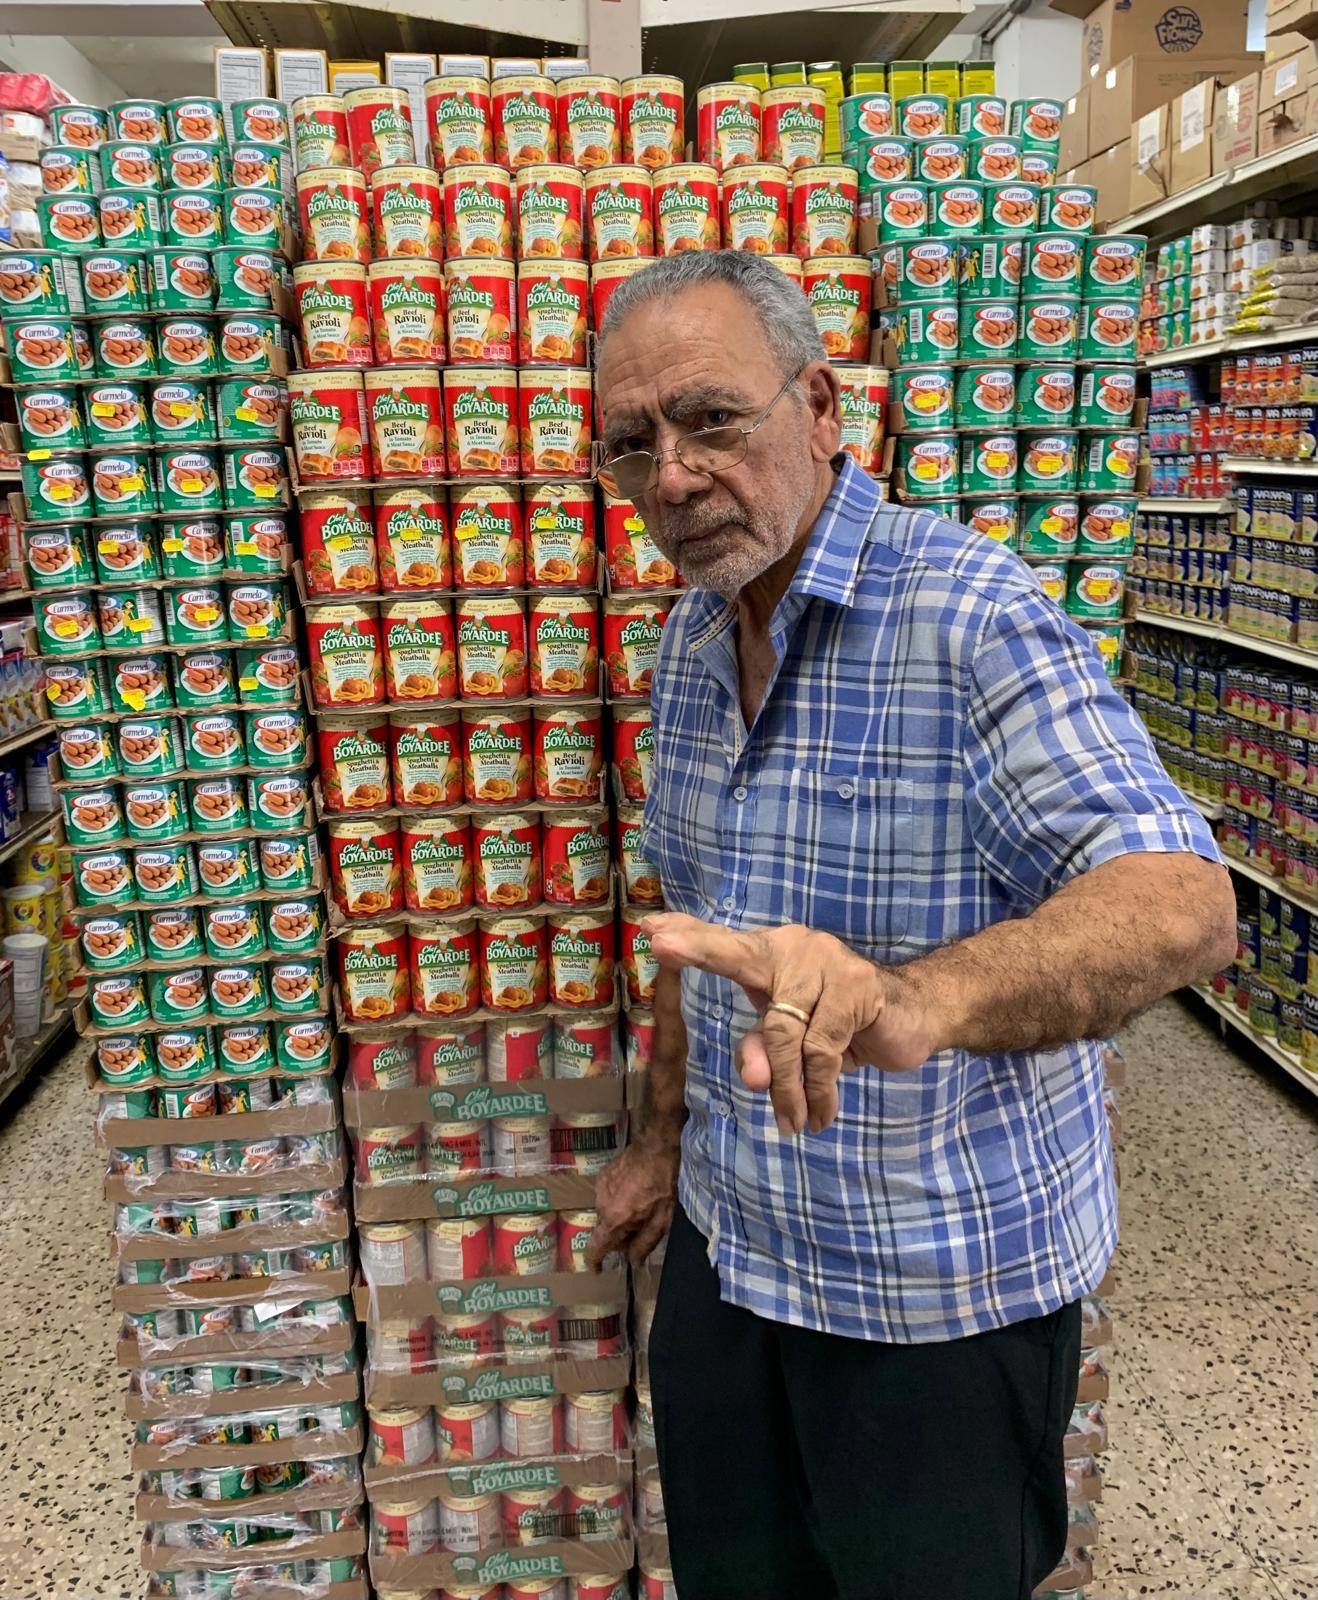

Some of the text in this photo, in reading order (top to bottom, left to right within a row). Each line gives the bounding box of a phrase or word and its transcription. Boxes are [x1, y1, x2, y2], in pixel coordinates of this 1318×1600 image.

[441, 97, 456, 110] Chef
[507, 97, 521, 109] Chef
[572, 97, 586, 109] Chef
[436, 104, 485, 121] BOYARDEE
[502, 104, 550, 121] BOYARDEE
[567, 105, 616, 121] BOYARDEE
[629, 105, 677, 122] BOYARDEE
[311, 188, 327, 202] Chef
[595, 188, 610, 201] Chef
[810, 188, 826, 201] Chef
[308, 195, 359, 214] BOYARDEE
[380, 195, 431, 214] BOYARDEE
[454, 195, 505, 214] BOYARDEE
[519, 195, 568, 214] BOYARDEE
[591, 195, 642, 214] BOYARDEE
[659, 195, 709, 214] BOYARDEE
[729, 195, 778, 214] BOYARDEE
[806, 196, 854, 215] BOYARDEE
[0, 261, 27, 271] Carmela
[90, 258, 116, 269] Carmela
[183, 257, 208, 267] Carmela
[386, 283, 403, 296] Chef
[531, 283, 548, 296] Chef
[382, 292, 436, 308] BOYARDEE
[527, 292, 580, 308] BOYARDEE
[310, 316, 341, 328] Ravioli
[317, 312, 331, 320] Beef
[394, 314, 426, 325] Ravioli
[25, 327, 56, 338] Carmela
[167, 326, 194, 336] Carmela
[226, 325, 253, 334] Carmela
[30, 396, 58, 406] Carmela
[99, 391, 127, 401] Carmela
[157, 390, 184, 400] Carmela
[376, 393, 394, 406] Chef
[458, 392, 474, 402] Chef
[533, 393, 550, 403] Chef
[372, 402, 428, 420] BOYARDEE
[453, 401, 509, 418] BOYARDEE
[528, 401, 584, 419] BOYARDEE
[384, 426, 416, 437] Ravioli
[464, 426, 497, 435] Ravioli
[540, 426, 572, 436] Ravioli
[178, 457, 206, 467] Carmela
[251, 455, 279, 465] Carmela
[98, 462, 125, 472] Carmela
[327, 514, 345, 524] Chef
[392, 511, 408, 520] Chef
[461, 510, 478, 522] Chef
[468, 540, 499, 548] Meatballs
[541, 538, 571, 547] Meatballs
[236, 590, 263, 600] Carmela
[391, 621, 408, 635] Chef
[461, 620, 476, 633] Chef
[541, 619, 558, 631] Chef
[325, 625, 342, 640] Chef
[458, 629, 509, 646] BOYARDEE
[536, 627, 590, 642] BOYARDEE
[320, 634, 375, 651] BOYARDEE
[388, 631, 442, 648] BOYARDEE
[549, 648, 578, 657] Meatballs
[191, 658, 218, 668] Carmela
[335, 657, 366, 667] Meatballs
[201, 720, 229, 731] Carmela
[64, 732, 90, 741] Carmela
[122, 728, 147, 737] Carmela
[401, 732, 419, 745] Chef
[473, 729, 490, 741] Chef
[548, 726, 565, 739] Chef
[338, 735, 356, 749] Chef
[397, 740, 450, 756] BOYARDEE
[469, 737, 522, 750] BOYARDEE
[543, 735, 595, 749] BOYARDEE
[554, 756, 585, 767] Ravioli
[131, 791, 158, 801] Carmela
[415, 838, 432, 851] Chef
[485, 835, 502, 848] Chef
[343, 844, 359, 854] Chef
[411, 845, 464, 862] BOYARDEE
[480, 843, 532, 858] BOYARDEE
[139, 856, 165, 866] Carmela
[340, 848, 394, 866] BOYARDEE
[88, 859, 116, 870] Carmela
[353, 869, 383, 880] Meatballs
[277, 904, 304, 915] Carmela
[155, 913, 182, 924] Carmela
[214, 912, 241, 923] Carmela
[88, 922, 114, 933] Carmela
[490, 940, 506, 951] Chef
[554, 934, 569, 946] Chef
[422, 945, 439, 957] Chef
[486, 947, 537, 960] BOYARDEE
[551, 942, 601, 955] BOYARDEE
[345, 954, 397, 970] BOYARDEE
[347, 949, 363, 962] Chef
[418, 950, 470, 966] BOYARDEE
[217, 971, 242, 982] Carmela
[430, 972, 460, 980] Meatballs
[228, 1028, 255, 1039] Carmela
[294, 1024, 322, 1035] Carmela
[101, 1040, 126, 1050] Carmela
[465, 1087, 489, 1105] Chef
[457, 1094, 546, 1120] BOYARDEE
[467, 1184, 494, 1200] Chef
[460, 1189, 548, 1215] BOYARDEE
[472, 1283, 497, 1299] Chef
[464, 1287, 550, 1313] BOYARDEE
[475, 1372, 499, 1388] Chef
[468, 1375, 553, 1401] BOYARDEE
[473, 1467, 558, 1494] BOYARDEE
[486, 1553, 508, 1568] Chef
[478, 1556, 563, 1583] BOYARDEE
